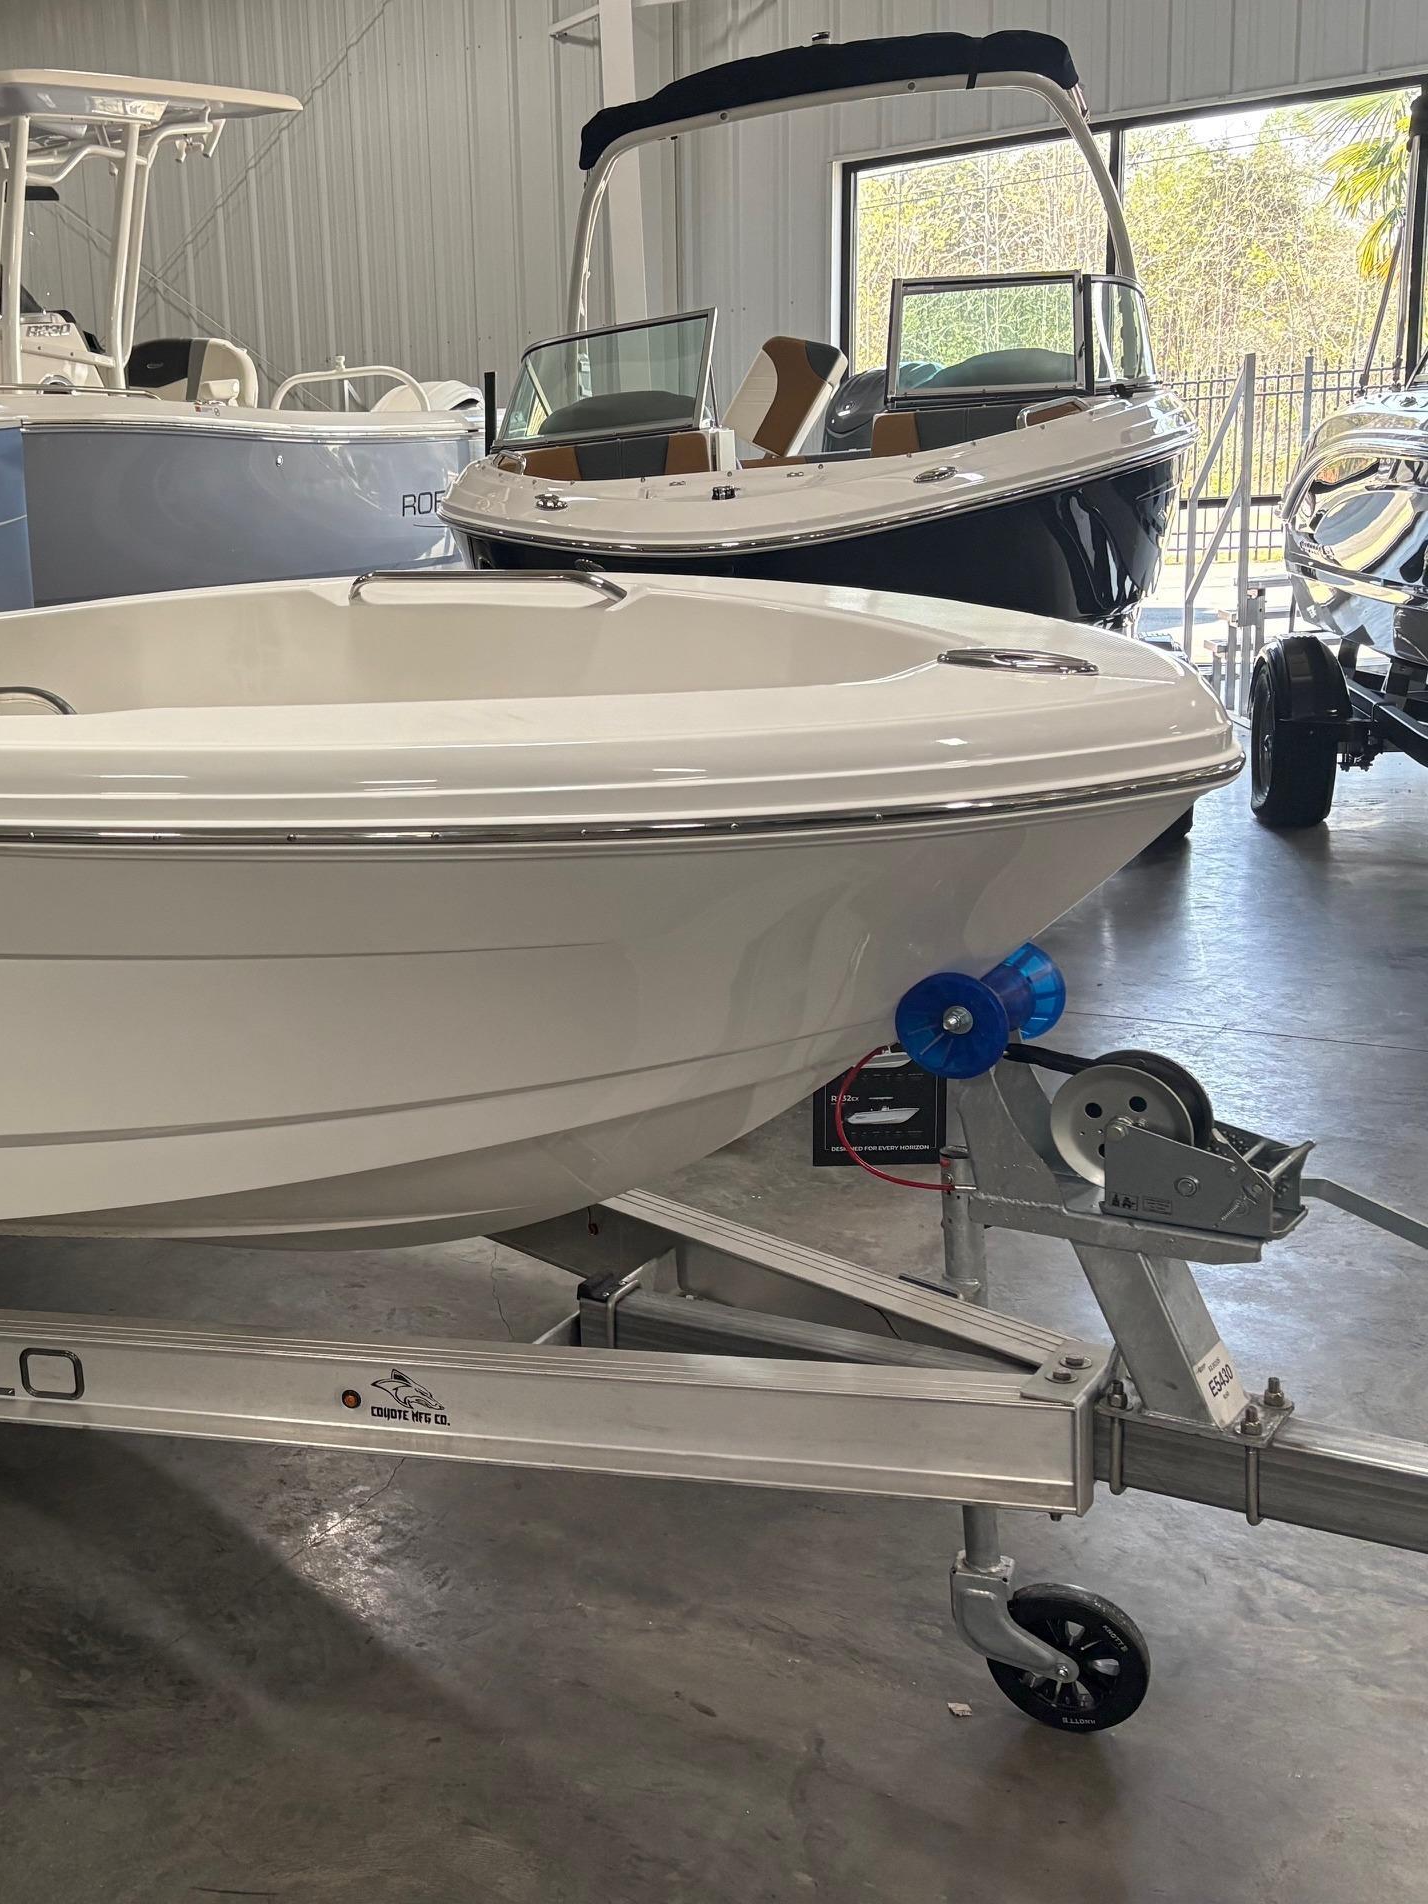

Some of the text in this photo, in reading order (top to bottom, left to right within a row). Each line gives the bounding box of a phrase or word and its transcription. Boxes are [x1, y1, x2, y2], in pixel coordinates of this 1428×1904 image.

[1208, 1363, 1234, 1398] E5430
[370, 1405, 451, 1427] COYOTE MFG CO.
